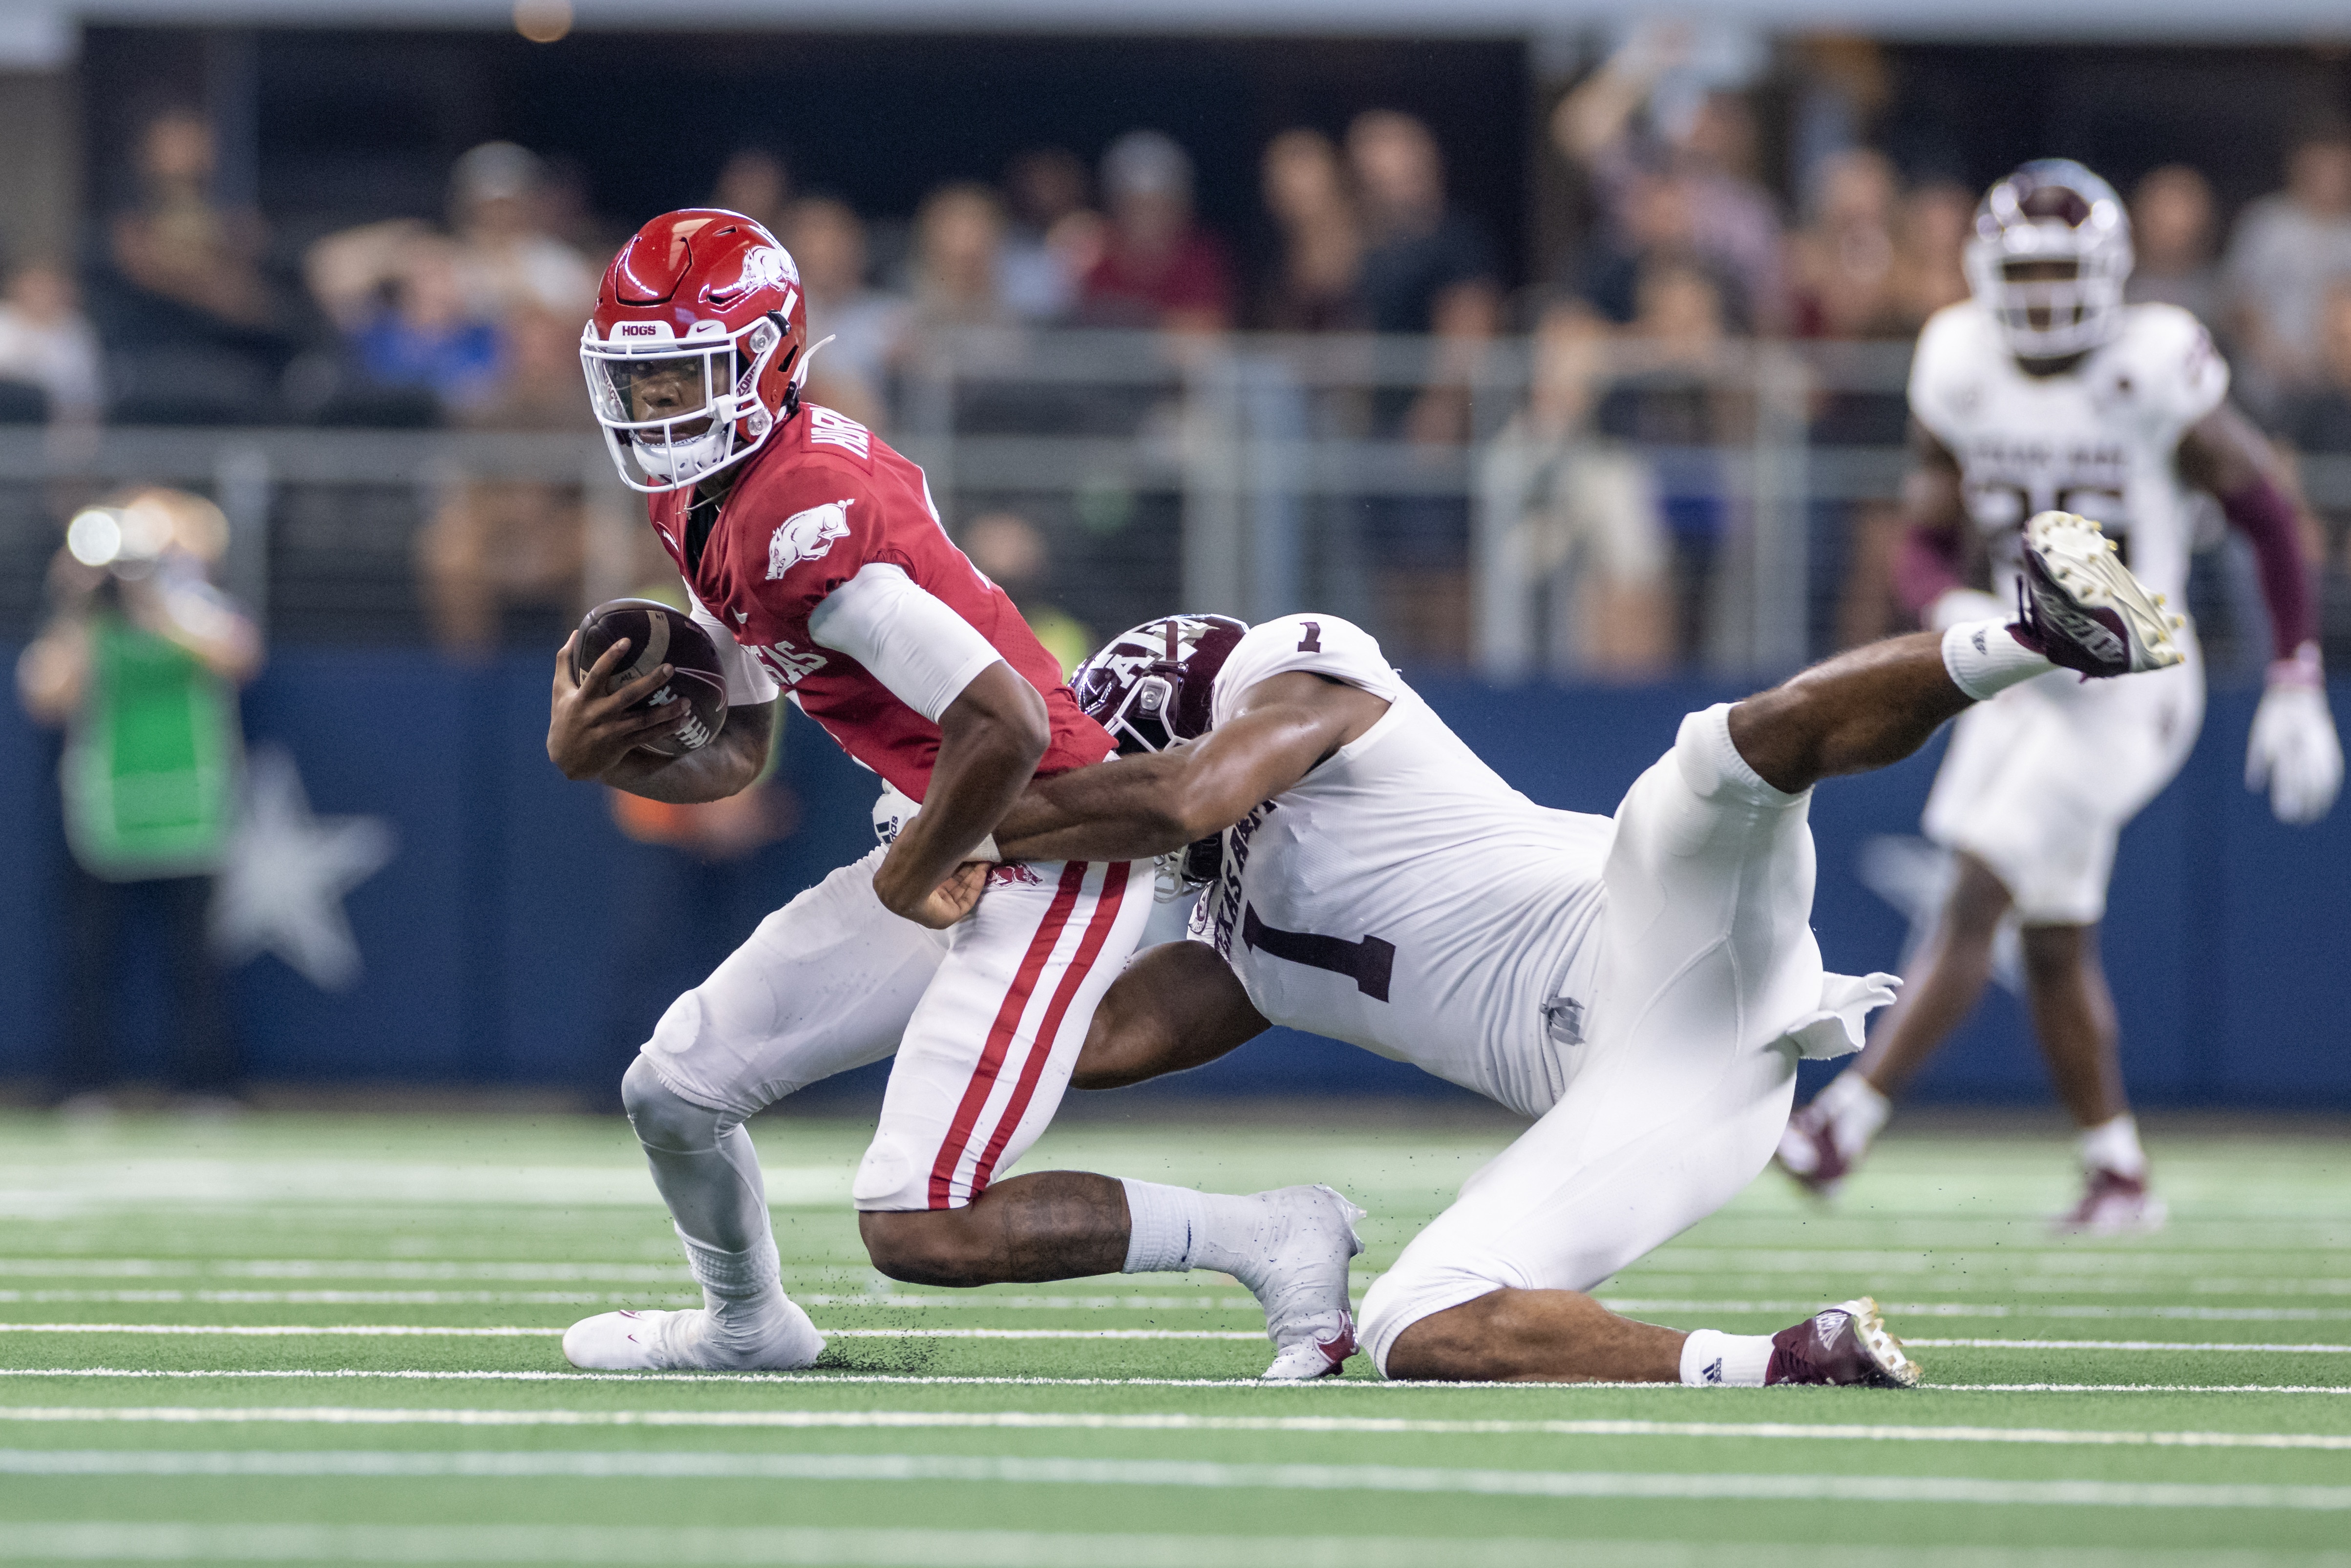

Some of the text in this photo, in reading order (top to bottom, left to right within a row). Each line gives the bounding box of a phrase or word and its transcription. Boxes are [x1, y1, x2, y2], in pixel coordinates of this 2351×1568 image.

[622, 325, 656, 336] HOGS
[1297, 622, 1321, 654] 1
[1242, 899, 1396, 1003] 1
